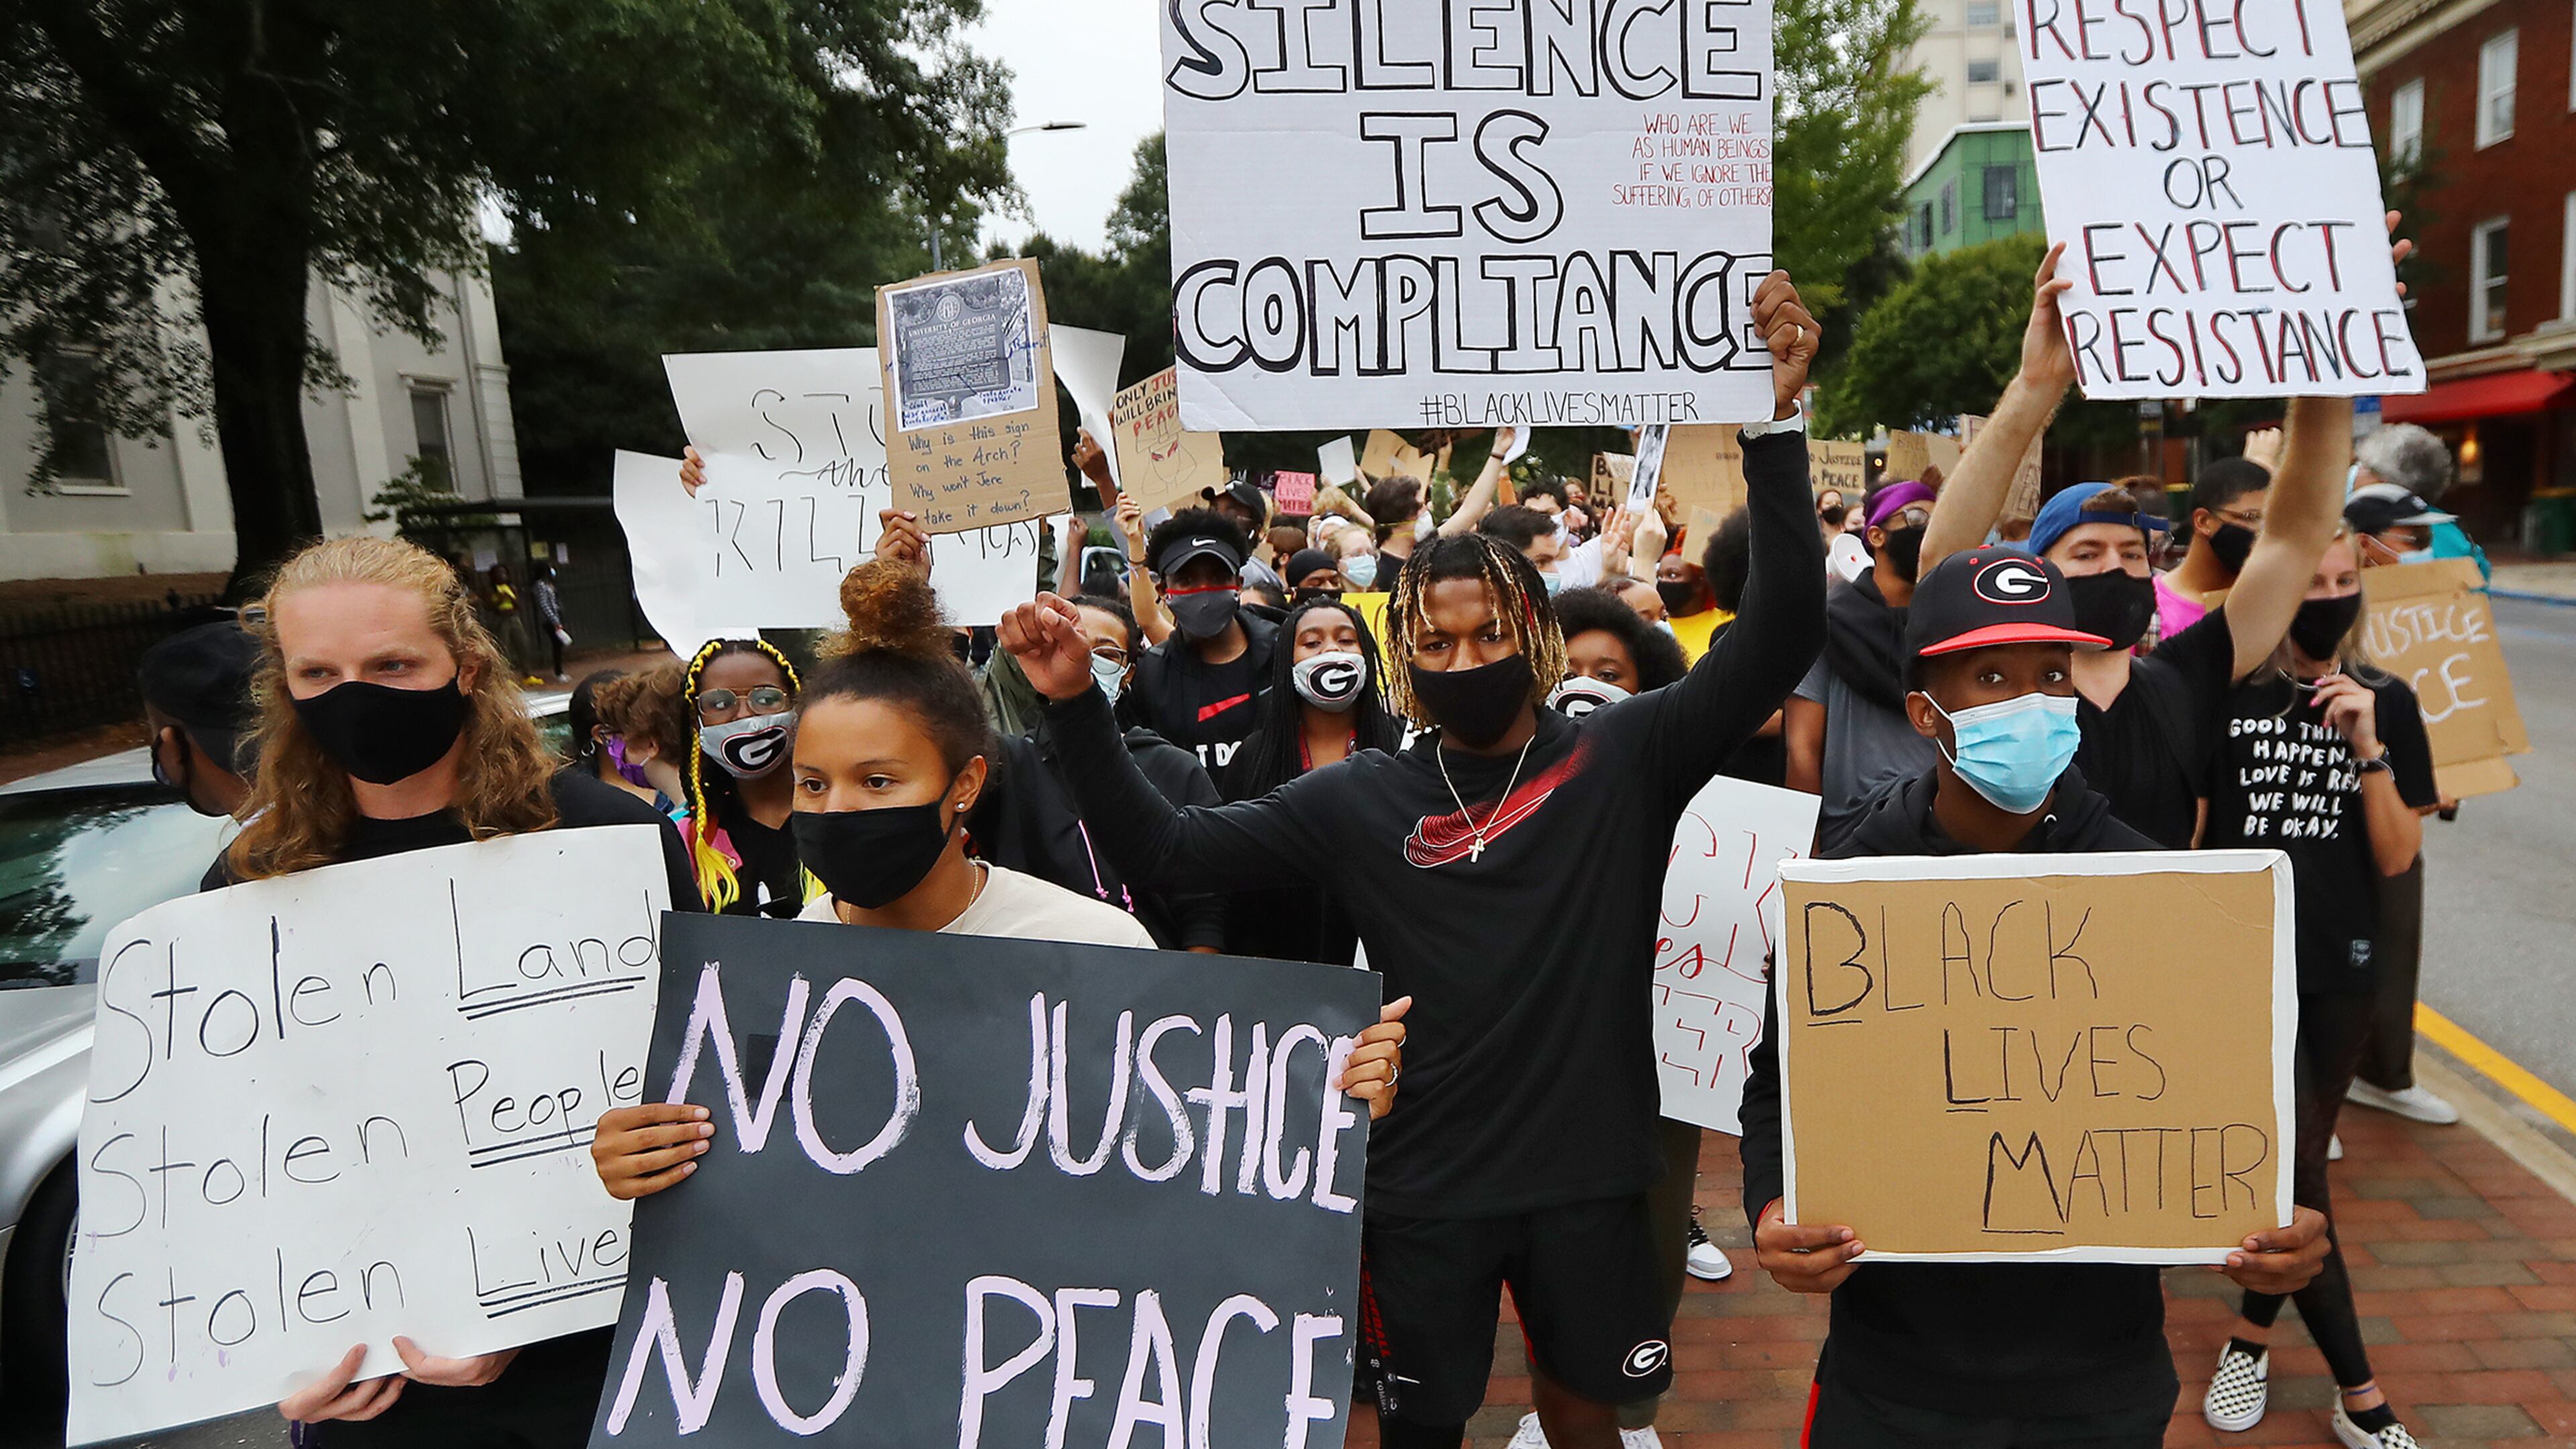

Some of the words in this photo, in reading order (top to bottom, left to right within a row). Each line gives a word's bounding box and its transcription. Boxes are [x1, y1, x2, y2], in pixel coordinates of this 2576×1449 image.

[1167, 0, 1762, 100] SILENCE
[2027, 0, 2315, 66] RESPECT
[1643, 113, 1680, 135] WHO
[1686, 113, 1721, 136] ARE
[1728, 113, 1752, 135] WE
[2030, 77, 2373, 152] EXISTENCE
[1631, 137, 1655, 160] AS
[1662, 138, 1711, 158] HUMAN
[1717, 137, 1771, 160] BEINGS
[1360, 109, 1564, 244] IS
[1639, 163, 1652, 182] IF
[1661, 164, 1682, 182] WE
[1690, 163, 1741, 184] IGNORE
[1744, 161, 1774, 183] THE
[2163, 154, 2245, 210] OR
[1611, 184, 1691, 209] SUFFERING
[1697, 188, 1714, 207] OF
[1719, 186, 1774, 208] OTHERS?
[2082, 219, 2356, 297] EXPECT
[908, 323, 949, 337] UNIVERSITY
[951, 320, 960, 329] OF
[962, 313, 997, 326] GEORGIA
[1171, 250, 1774, 377] COMPLIANCE
[2066, 304, 2413, 387] RESISTANCE
[1115, 403, 1144, 426] WILL
[1145, 386, 1177, 412] BRIN
[1116, 382, 1147, 409] ONLY
[1151, 368, 1177, 392] JUS
[1133, 403, 1179, 437] PEAC
[1419, 391, 1699, 427] #BLACKLIVESMATTER
[908, 433, 933, 455] Why
[942, 432, 956, 445] is
[969, 426, 996, 441] this
[1005, 421, 1030, 438] sign
[916, 462, 930, 473] on
[944, 455, 963, 468] the
[973, 439, 1022, 467] Arch?
[910, 483, 935, 502] Why
[1278, 488, 1309, 499] LIVES
[1279, 472, 1313, 486] BLACK
[1821, 468, 1860, 488] PEACE
[924, 508, 953, 525] take
[966, 504, 979, 518] it
[990, 489, 1030, 515] down?
[2362, 602, 2490, 659] USTICE
[2228, 716, 2287, 738] GOOD
[2252, 739, 2351, 767] HAPPEN
[2239, 763, 2292, 788] LOVE
[2297, 769, 2317, 788] IS
[2248, 792, 2285, 812] WE
[2291, 791, 2343, 817] WILL
[2243, 814, 2269, 838] BE
[2281, 814, 2339, 839] OKAY.
[1805, 900, 2099, 1016] BLACK
[89, 913, 397, 1104] Stolen
[448, 877, 663, 1001] Land
[1943, 1023, 2167, 1105] LIVES
[665, 961, 922, 1177] NO
[962, 990, 1359, 1214] JUSTICE
[84, 1114, 409, 1238] Stolen
[445, 1049, 642, 1147] People
[1982, 1123, 2269, 1229] MATTER
[92, 1247, 404, 1387] Stolen
[467, 1222, 632, 1298] Live
[606, 1268, 870, 1438] NO
[957, 1272, 1344, 1449] PEACE
